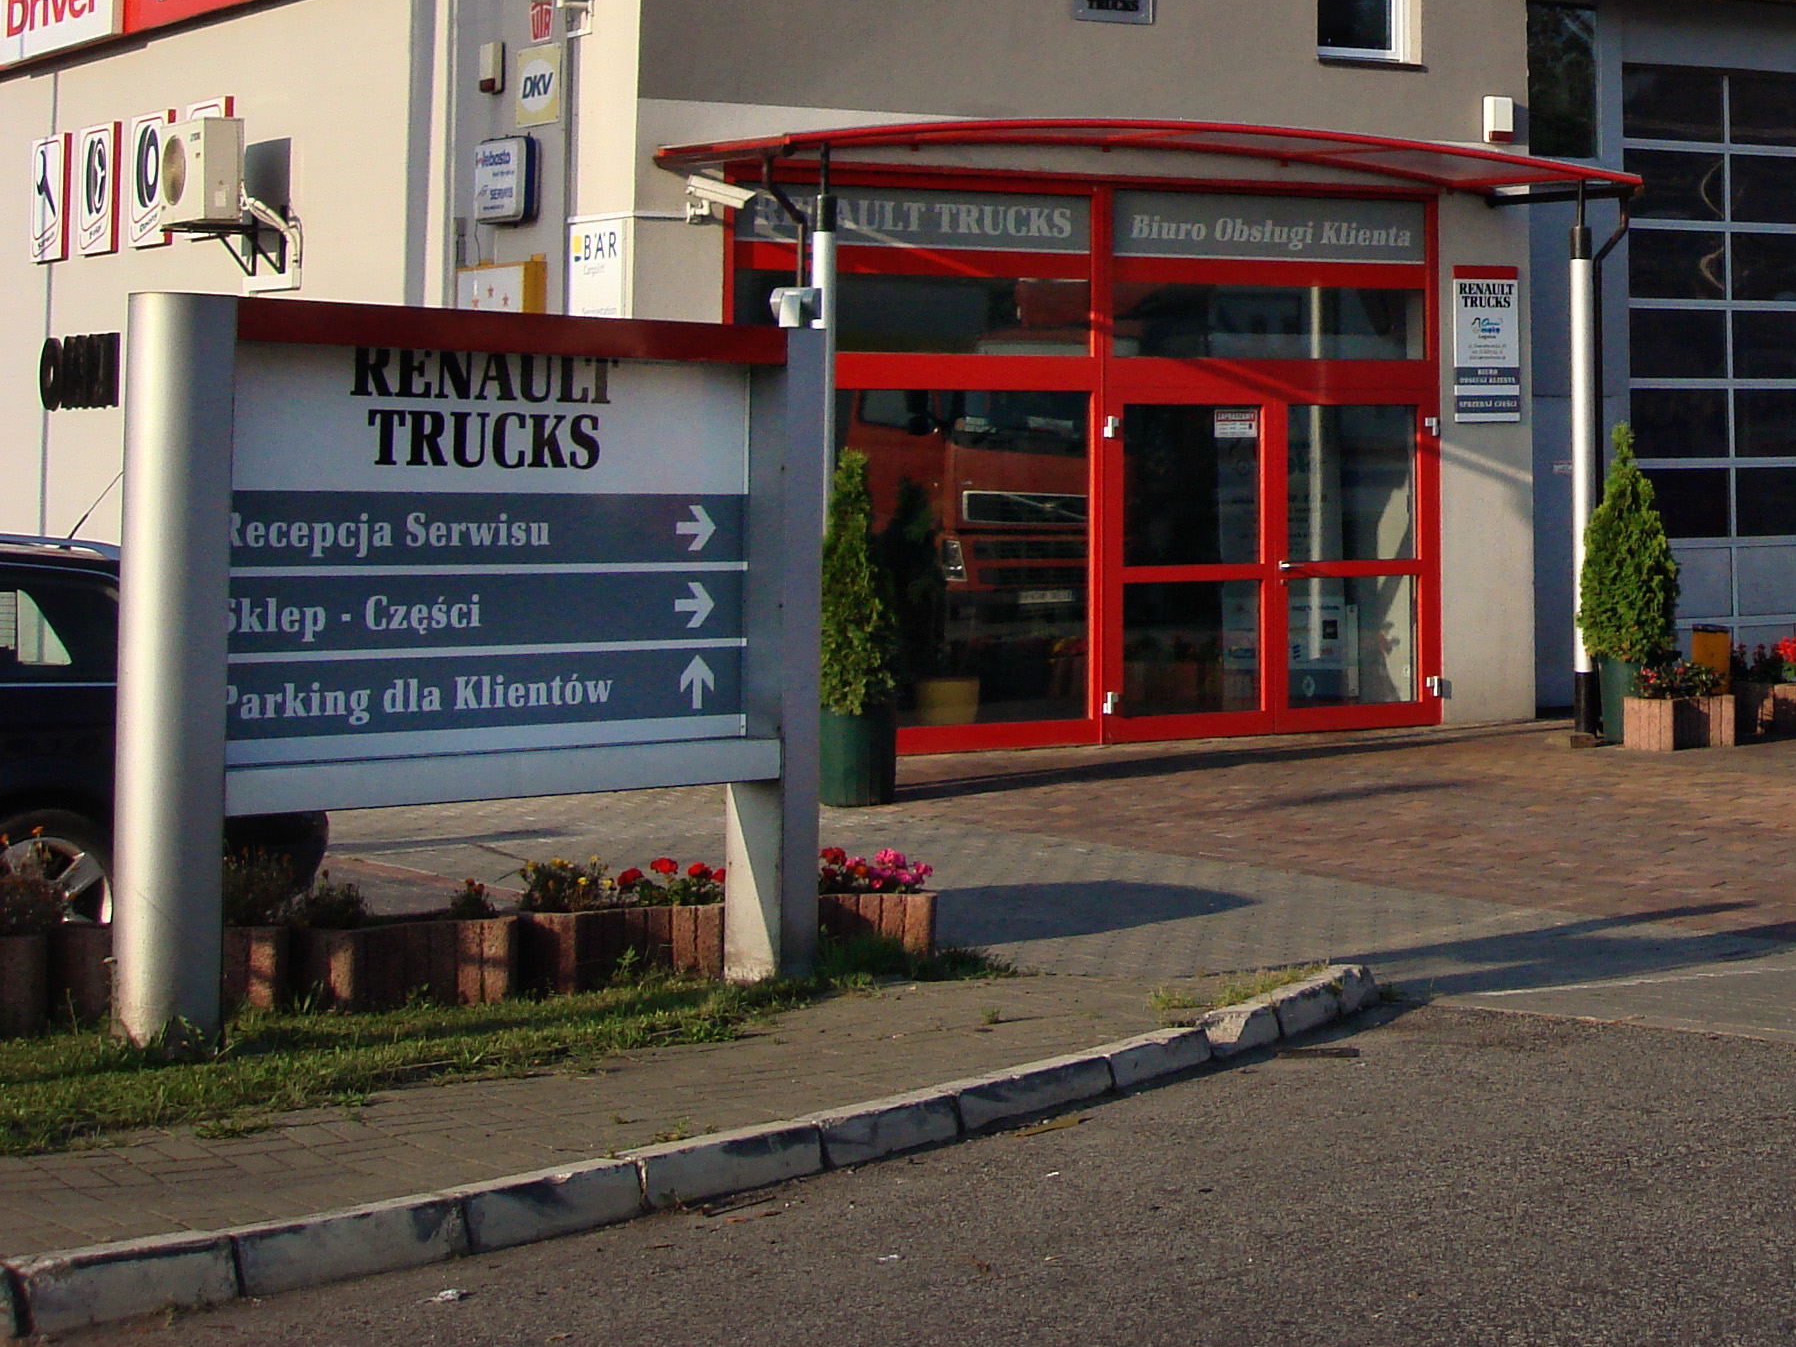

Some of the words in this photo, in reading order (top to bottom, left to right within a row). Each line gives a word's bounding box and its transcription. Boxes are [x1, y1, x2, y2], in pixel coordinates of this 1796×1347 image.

[522, 72, 553, 99] DKV
[754, 196, 925, 232] REAULT
[934, 203, 1072, 238] TRUCKS
[1131, 214, 1206, 240] Biuro
[1215, 217, 1312, 250] Obsługi
[1320, 221, 1411, 247] Klienta
[583, 231, 617, 261] BÄR
[1459, 283, 1514, 295] RENAULT
[1462, 296, 1511, 308] TRUCKS
[350, 348, 619, 404] RENAULT
[368, 409, 600, 470] TRUCKS
[406, 512, 550, 547] Serwisu
[365, 594, 482, 634] Części
[383, 679, 442, 714] dla
[454, 673, 612, 710] Klientów
